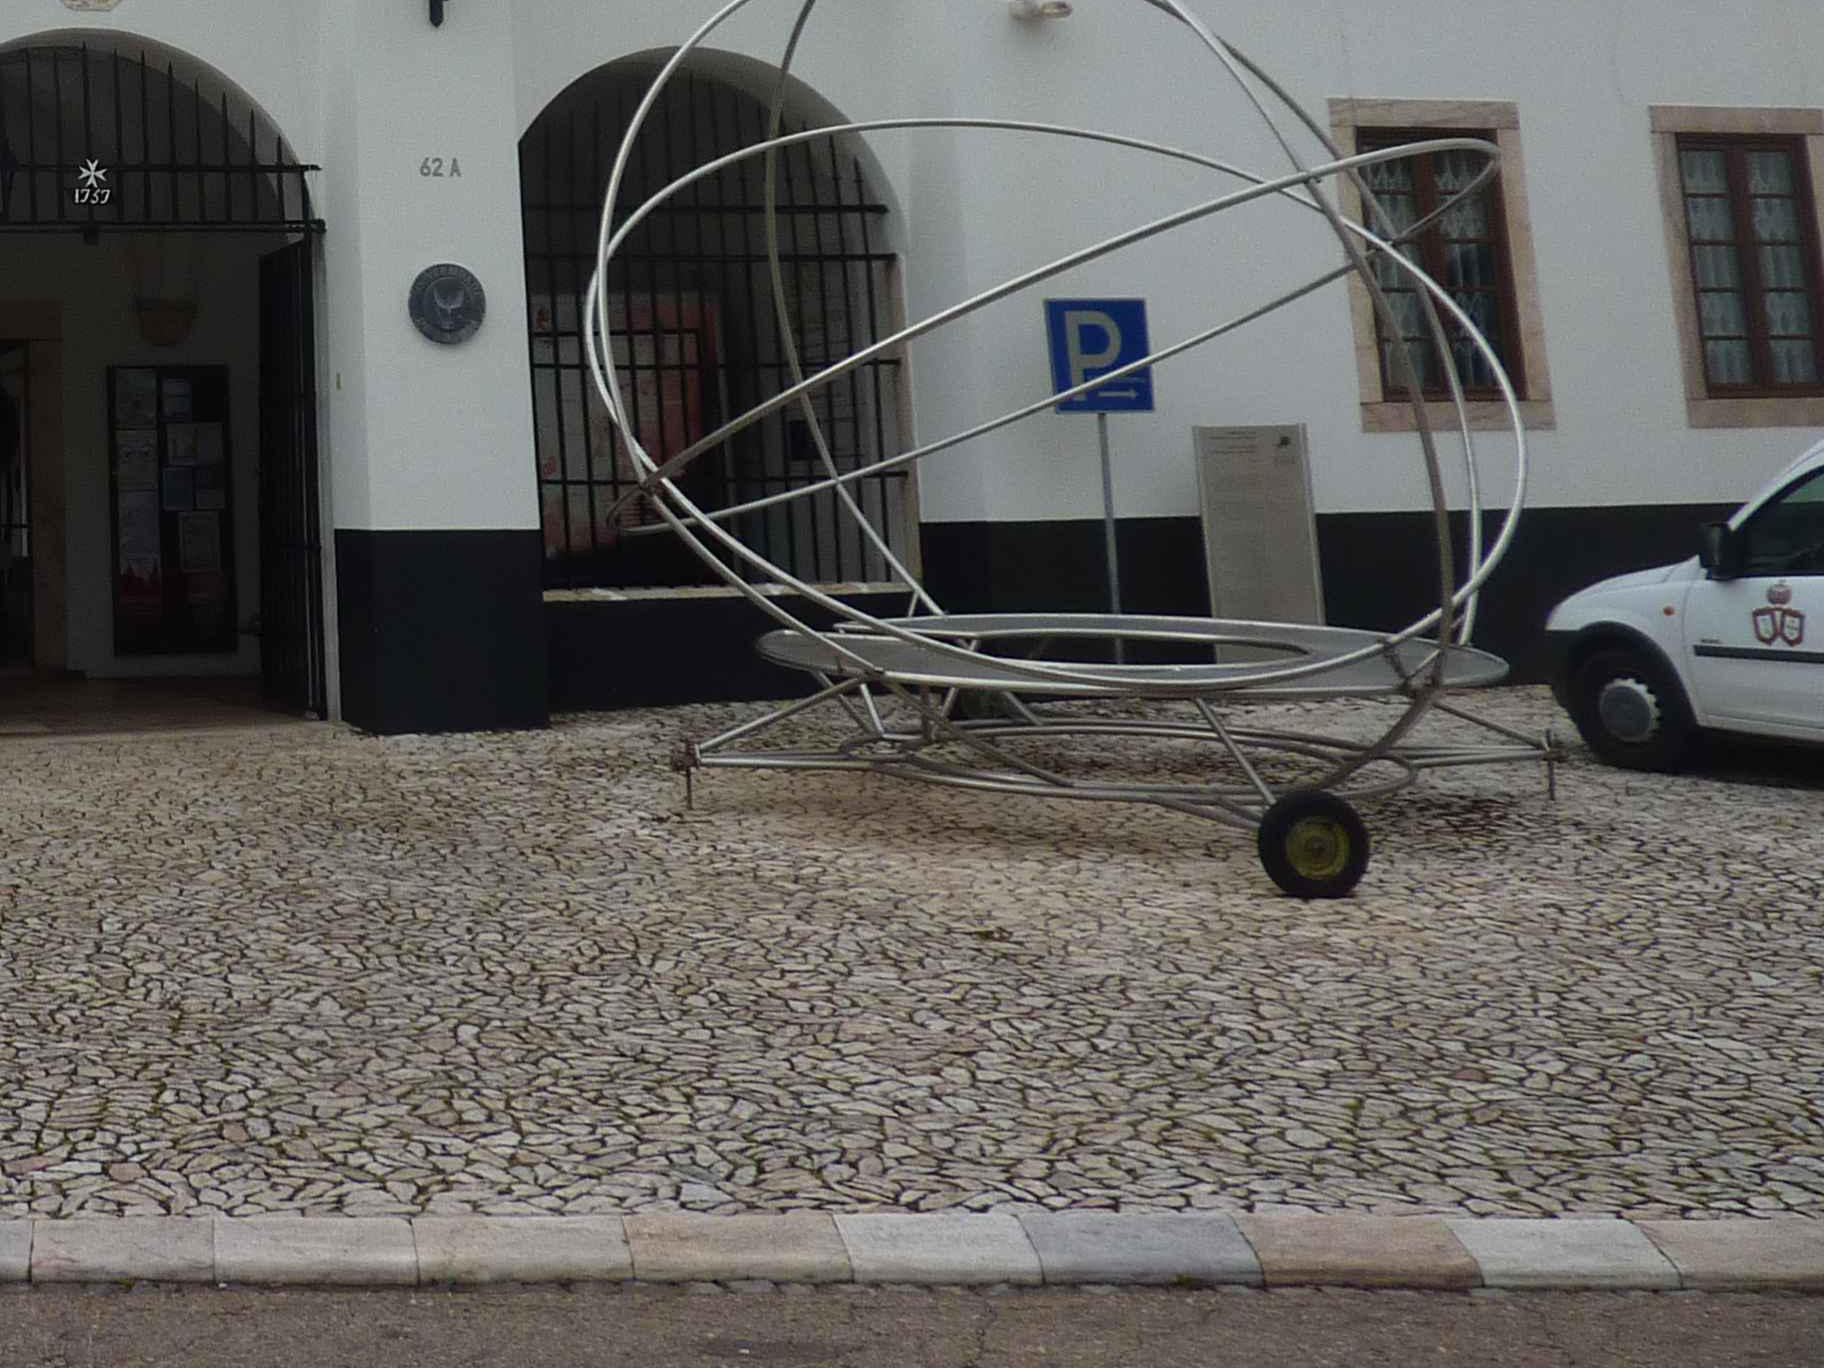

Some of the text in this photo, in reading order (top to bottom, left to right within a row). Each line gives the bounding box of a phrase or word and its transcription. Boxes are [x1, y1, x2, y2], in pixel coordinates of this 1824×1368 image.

[420, 157, 462, 177] 62 A
[1064, 311, 1121, 400] P
